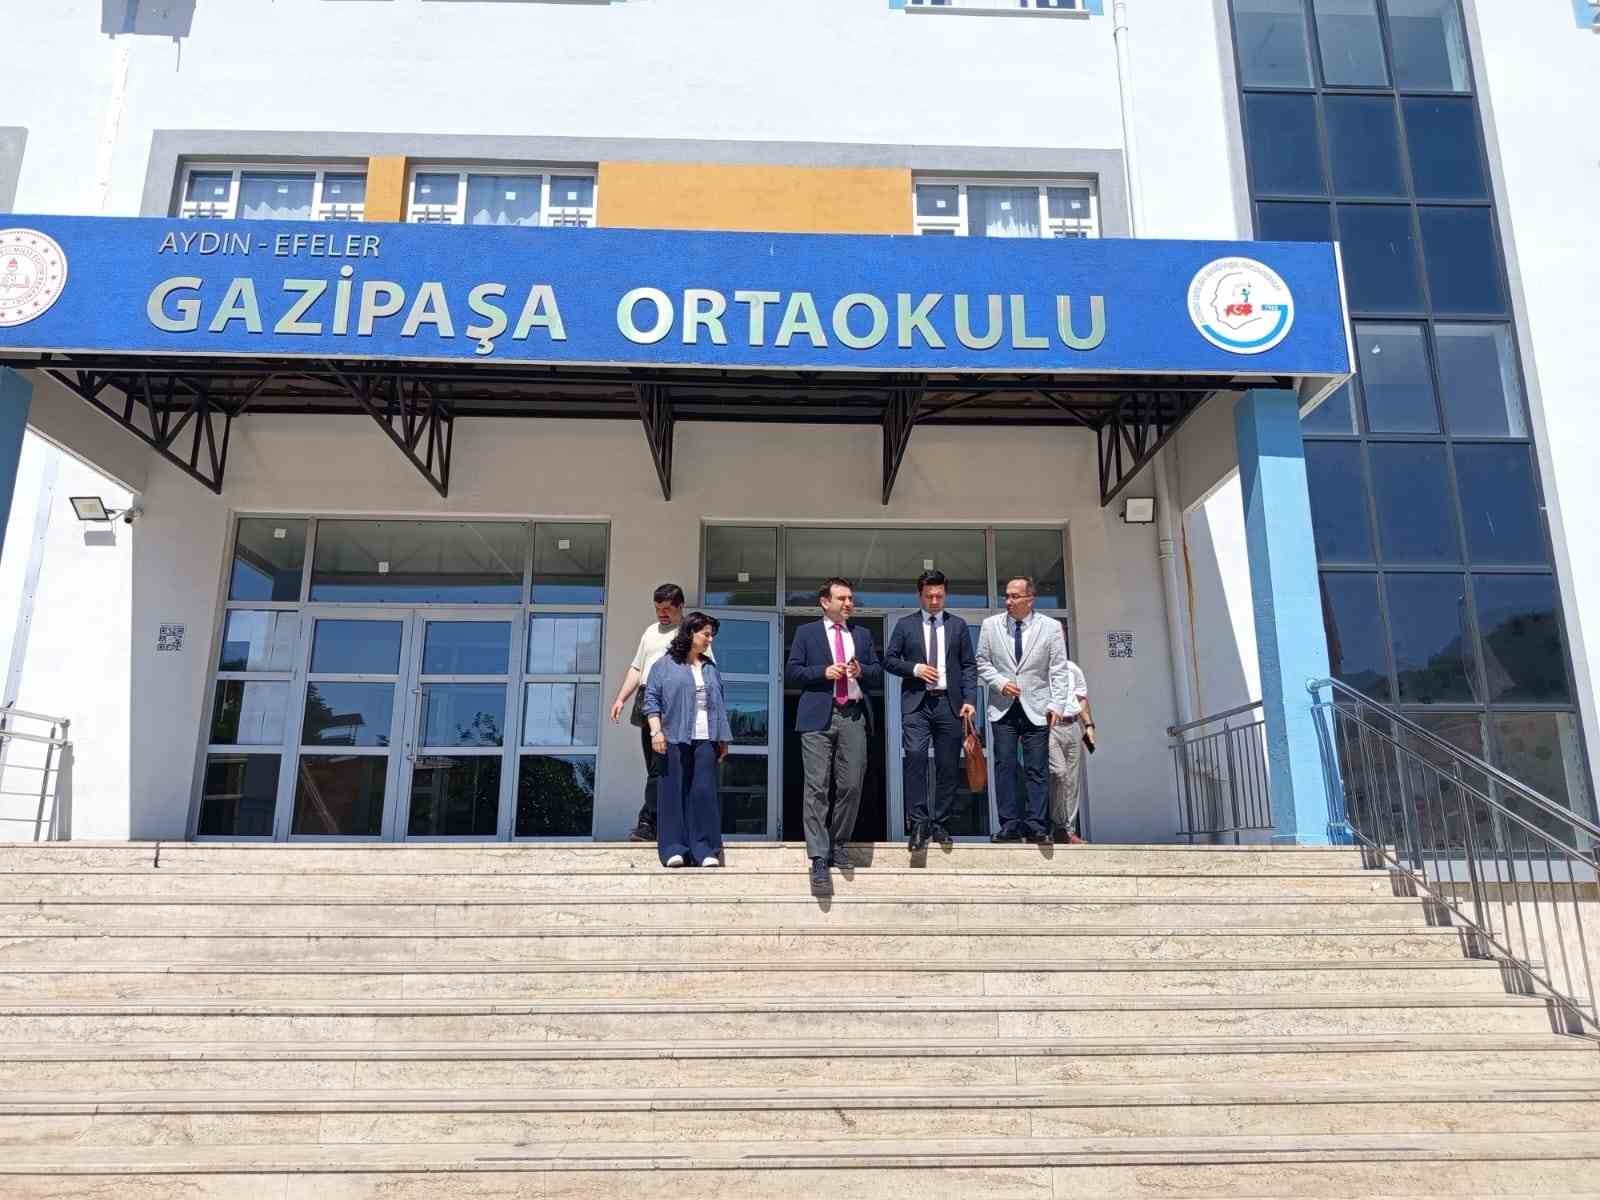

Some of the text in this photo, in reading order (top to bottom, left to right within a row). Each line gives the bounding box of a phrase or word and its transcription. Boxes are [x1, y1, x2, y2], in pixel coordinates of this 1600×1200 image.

[158, 231, 251, 256] AYDIN
[274, 233, 381, 258] EFELER
[146, 264, 567, 354] GAZİPAŞA
[615, 286, 1108, 351] ORTAOKULU
